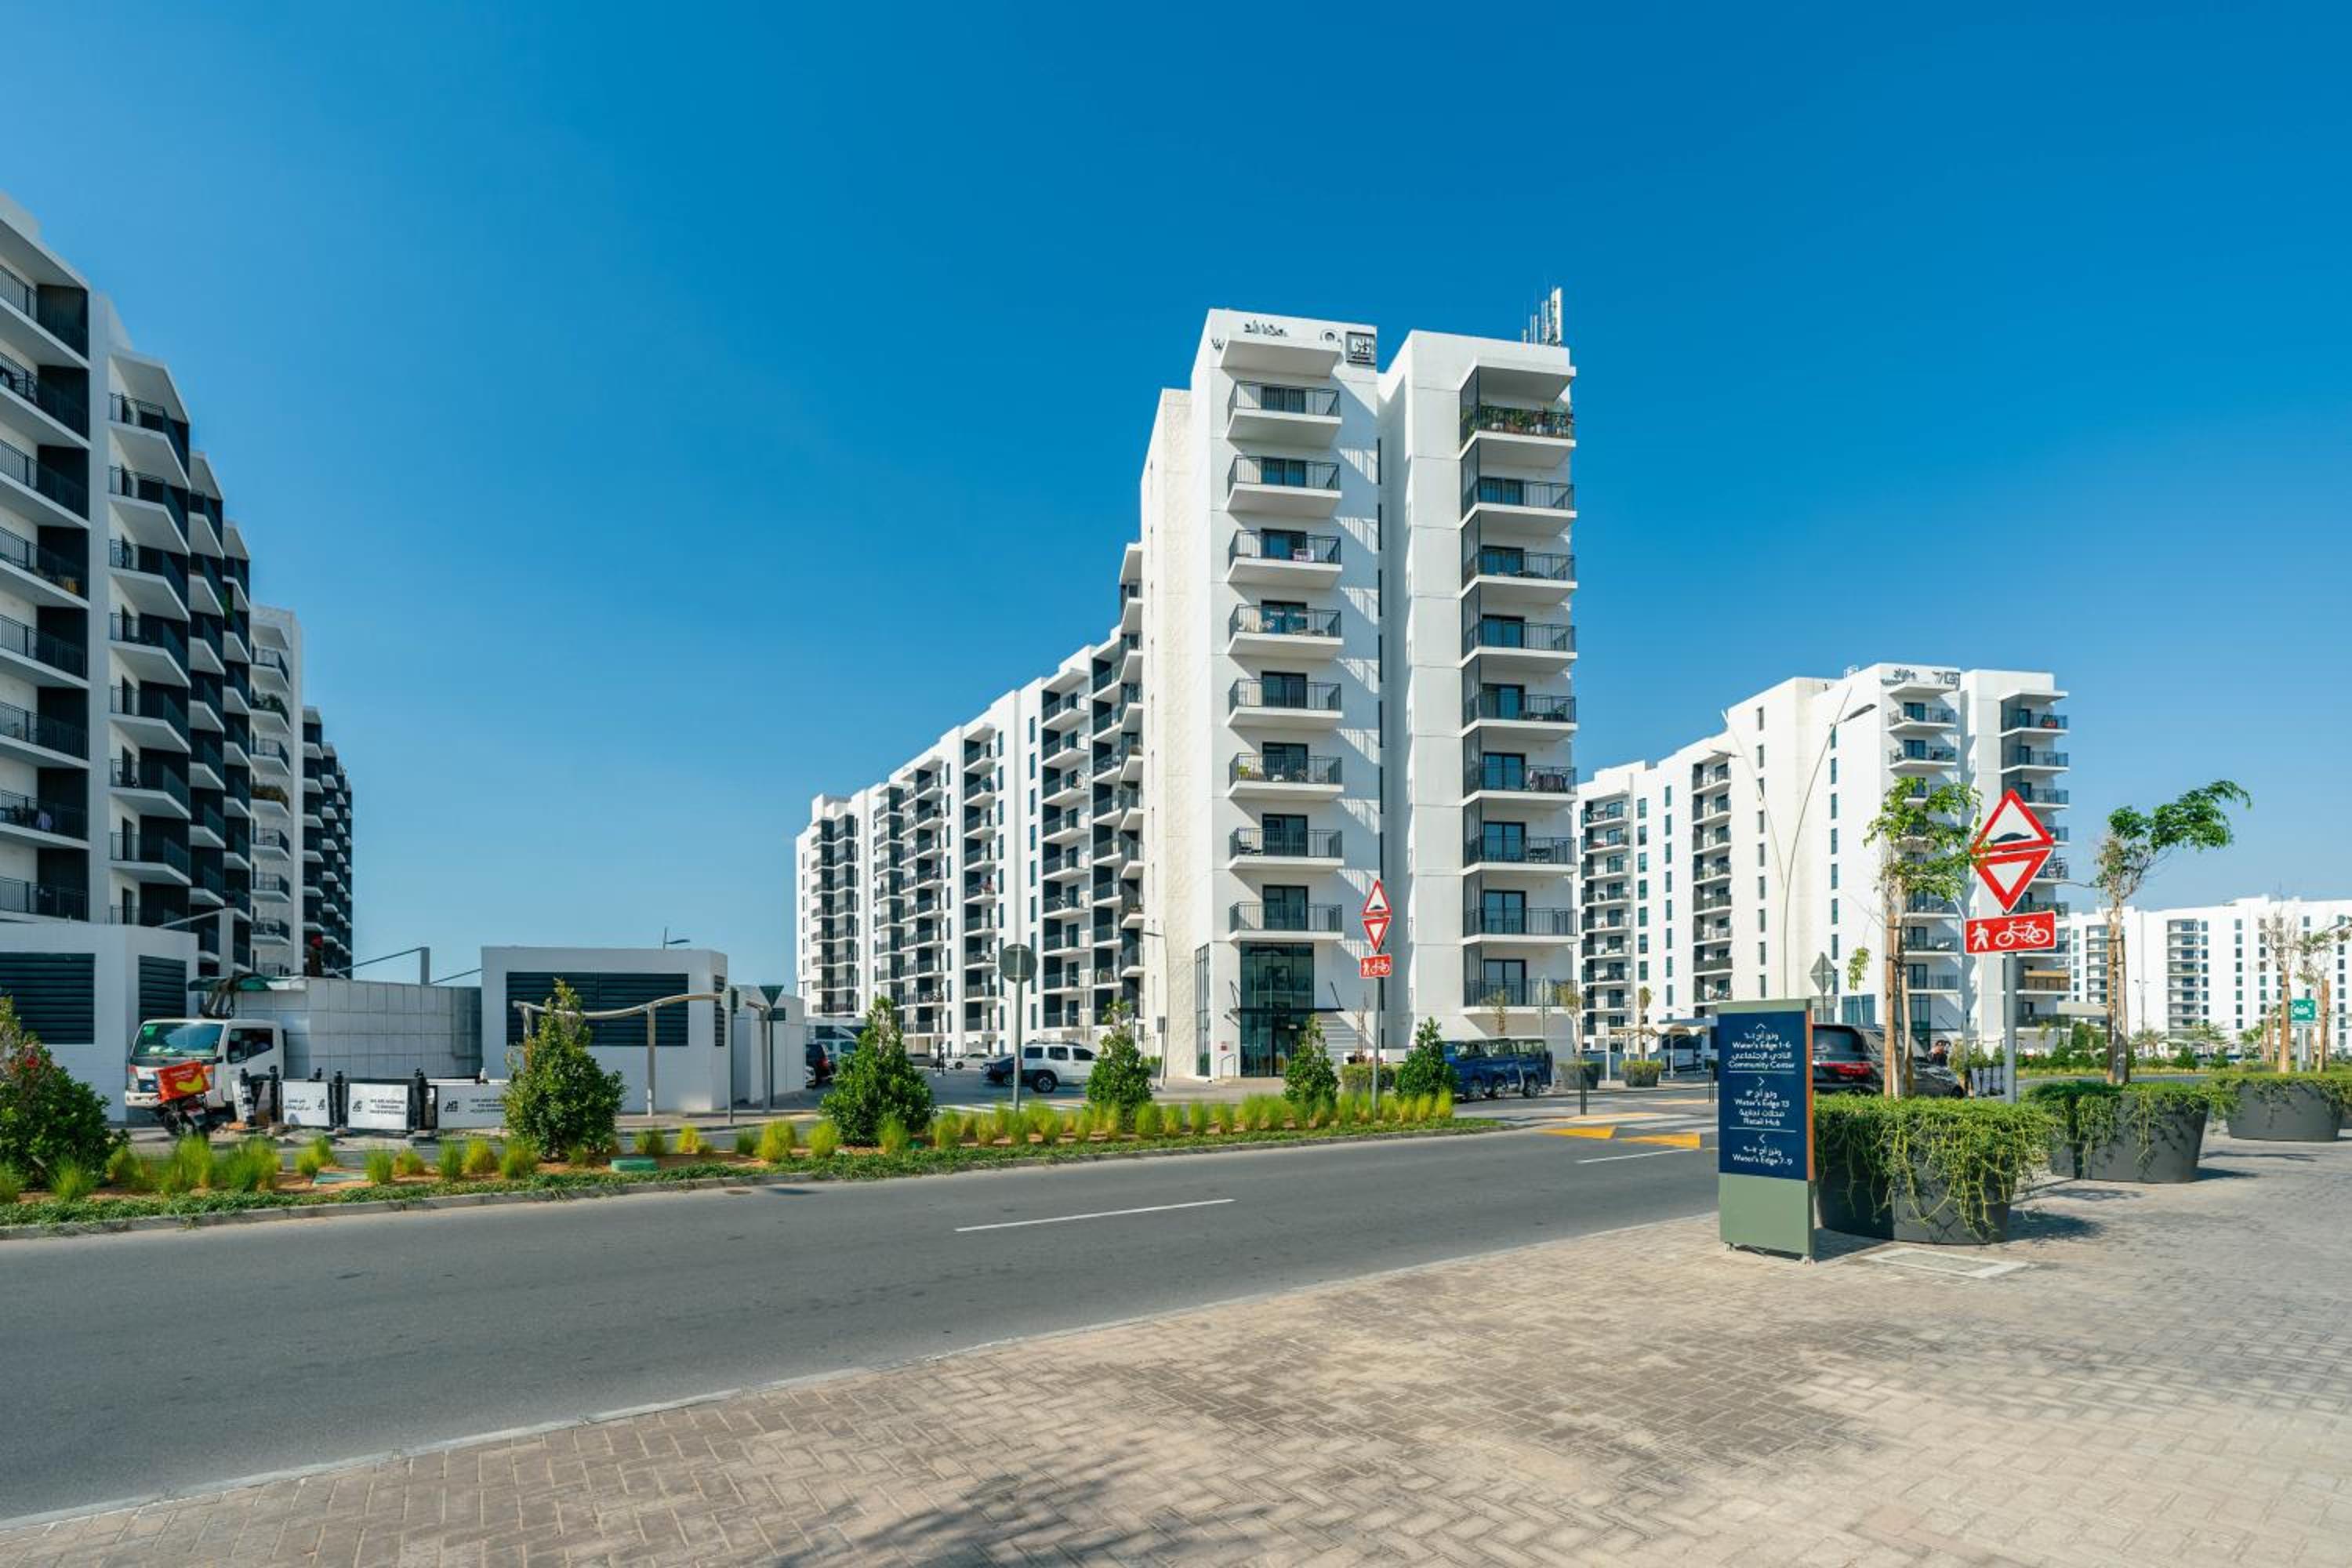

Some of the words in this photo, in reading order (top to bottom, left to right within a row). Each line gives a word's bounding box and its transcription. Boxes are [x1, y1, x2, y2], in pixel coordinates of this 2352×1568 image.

[1760, 1042, 1777, 1051] Edge
[1762, 1099, 1780, 1109] Edge
[1733, 1153, 1759, 1162] Water's
[1760, 1156, 1779, 1166] Edge
[1780, 1157, 1793, 1166] 7-9
